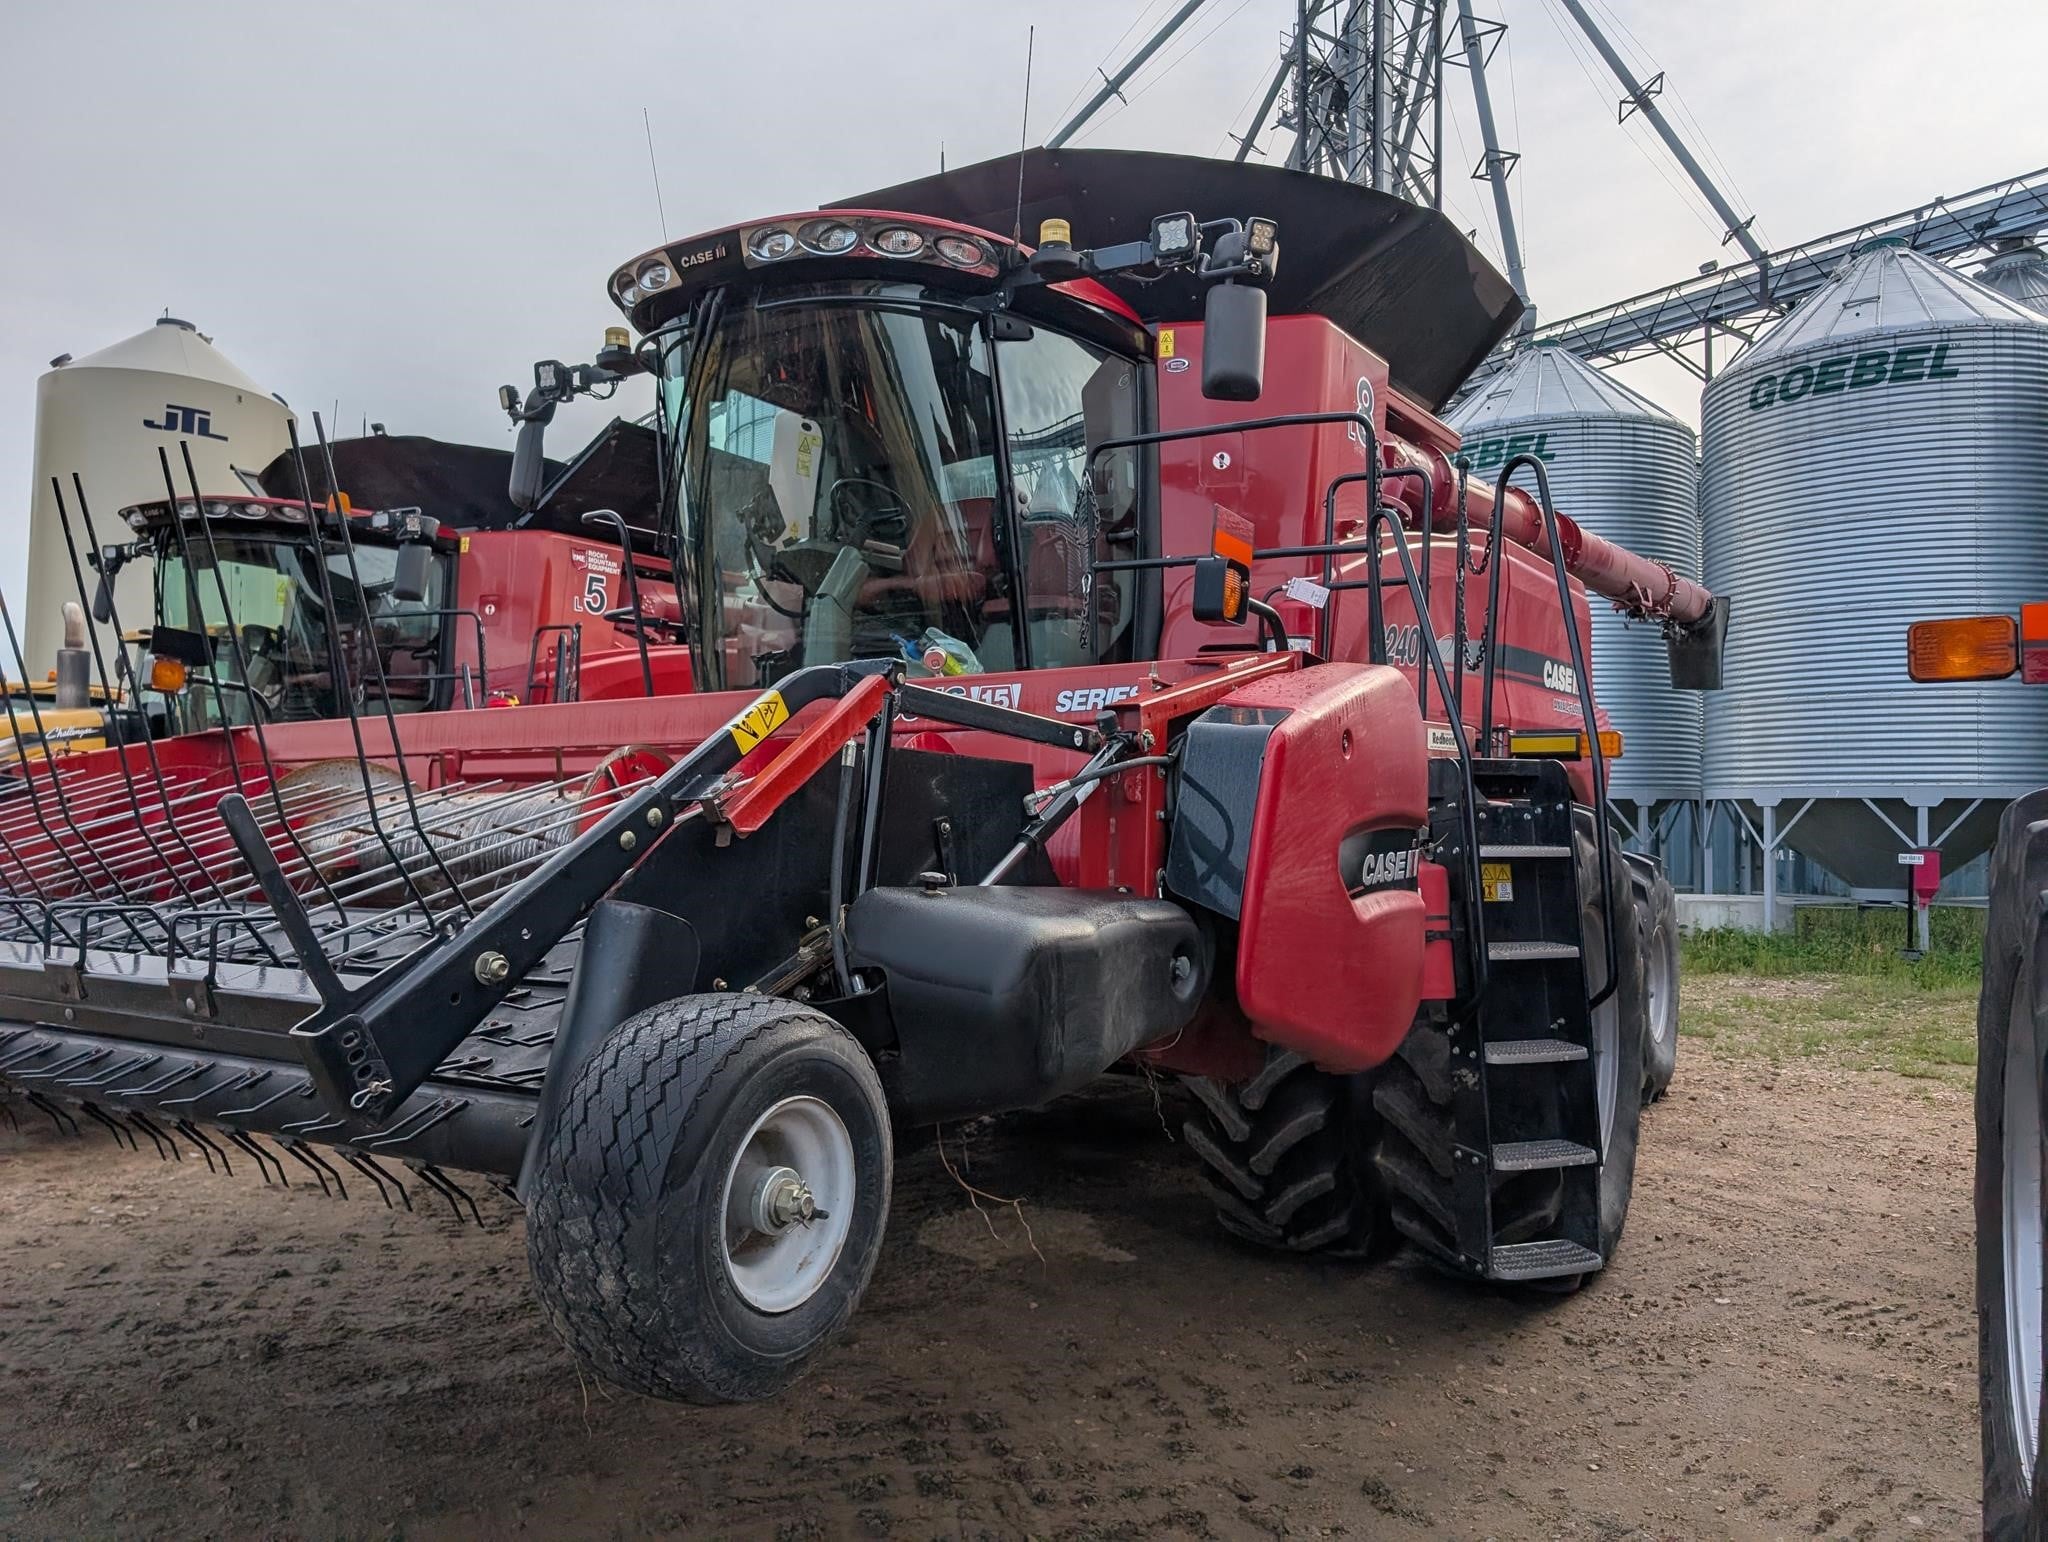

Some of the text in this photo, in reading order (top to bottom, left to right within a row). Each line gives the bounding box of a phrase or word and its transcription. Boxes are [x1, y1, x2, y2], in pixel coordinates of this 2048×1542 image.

[681, 250, 714, 268] CASE
[1750, 343, 1960, 411] GOEBEL
[143, 403, 229, 442] JTL
[1445, 432, 1556, 471] EBEL
[588, 550, 608, 560] ROCKY
[588, 557, 618, 568] MOUNTAIN
[588, 563, 621, 576] EQUIPMENT
[1384, 624, 1421, 668] 240
[1543, 660, 1573, 693] CASE
[981, 688, 1010, 709] 15
[1362, 850, 1407, 886] CASE
